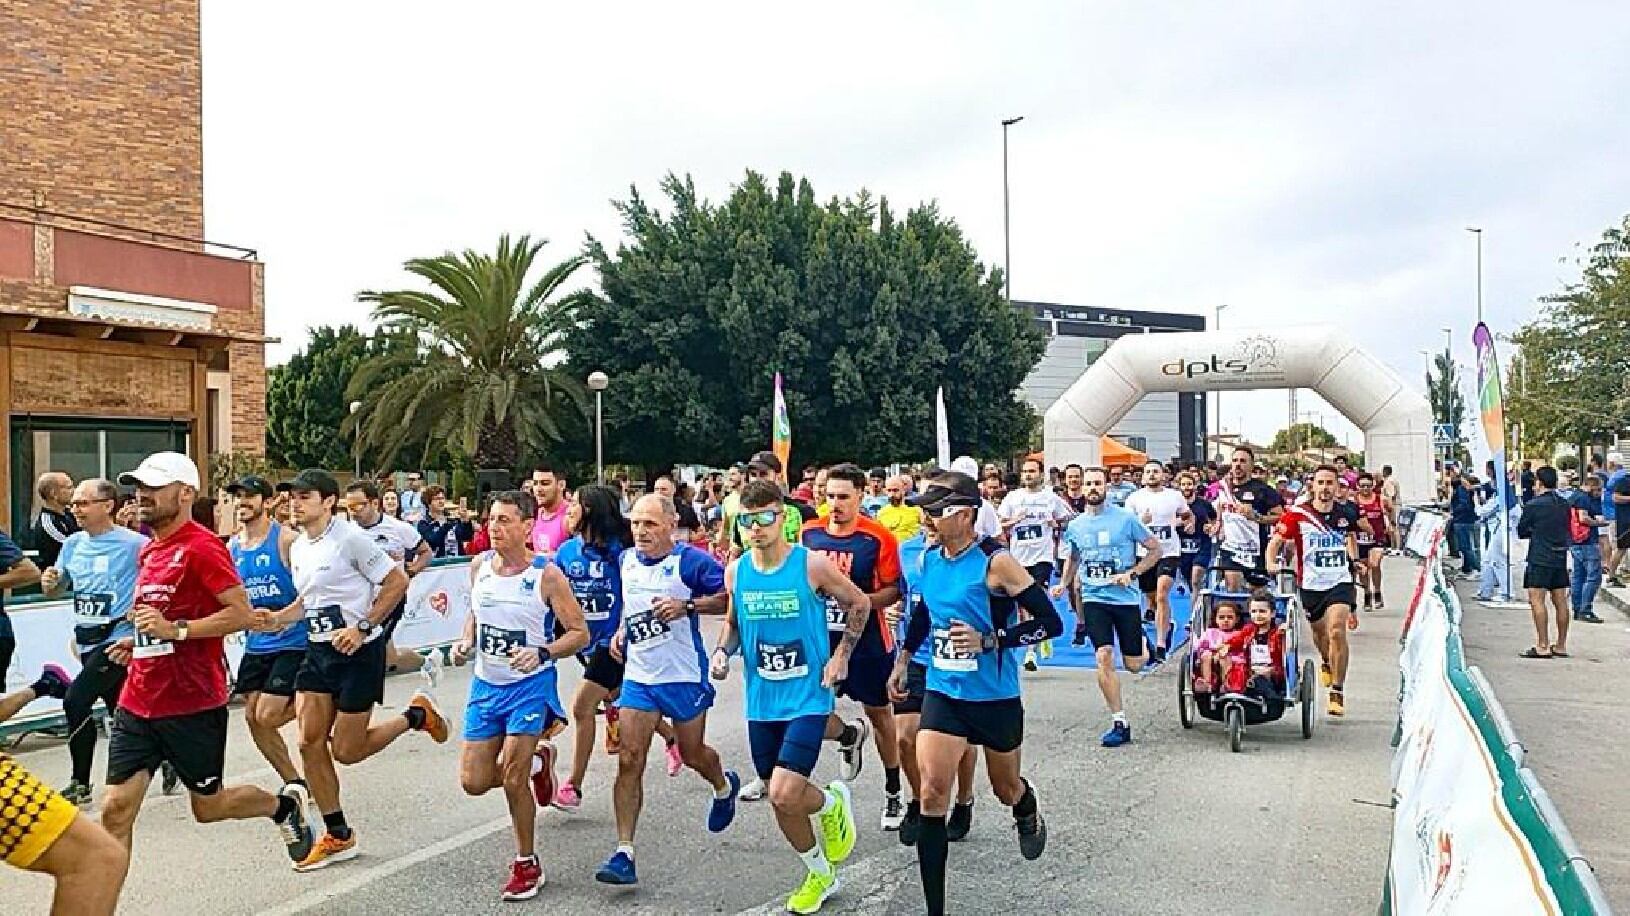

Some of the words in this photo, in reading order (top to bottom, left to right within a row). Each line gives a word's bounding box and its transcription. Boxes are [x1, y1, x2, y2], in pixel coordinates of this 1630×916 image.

[1161, 354, 1247, 378] dpts
[76, 602, 106, 616] 307
[308, 616, 333, 633] 55
[629, 617, 663, 642] 336
[761, 651, 798, 670] 367
